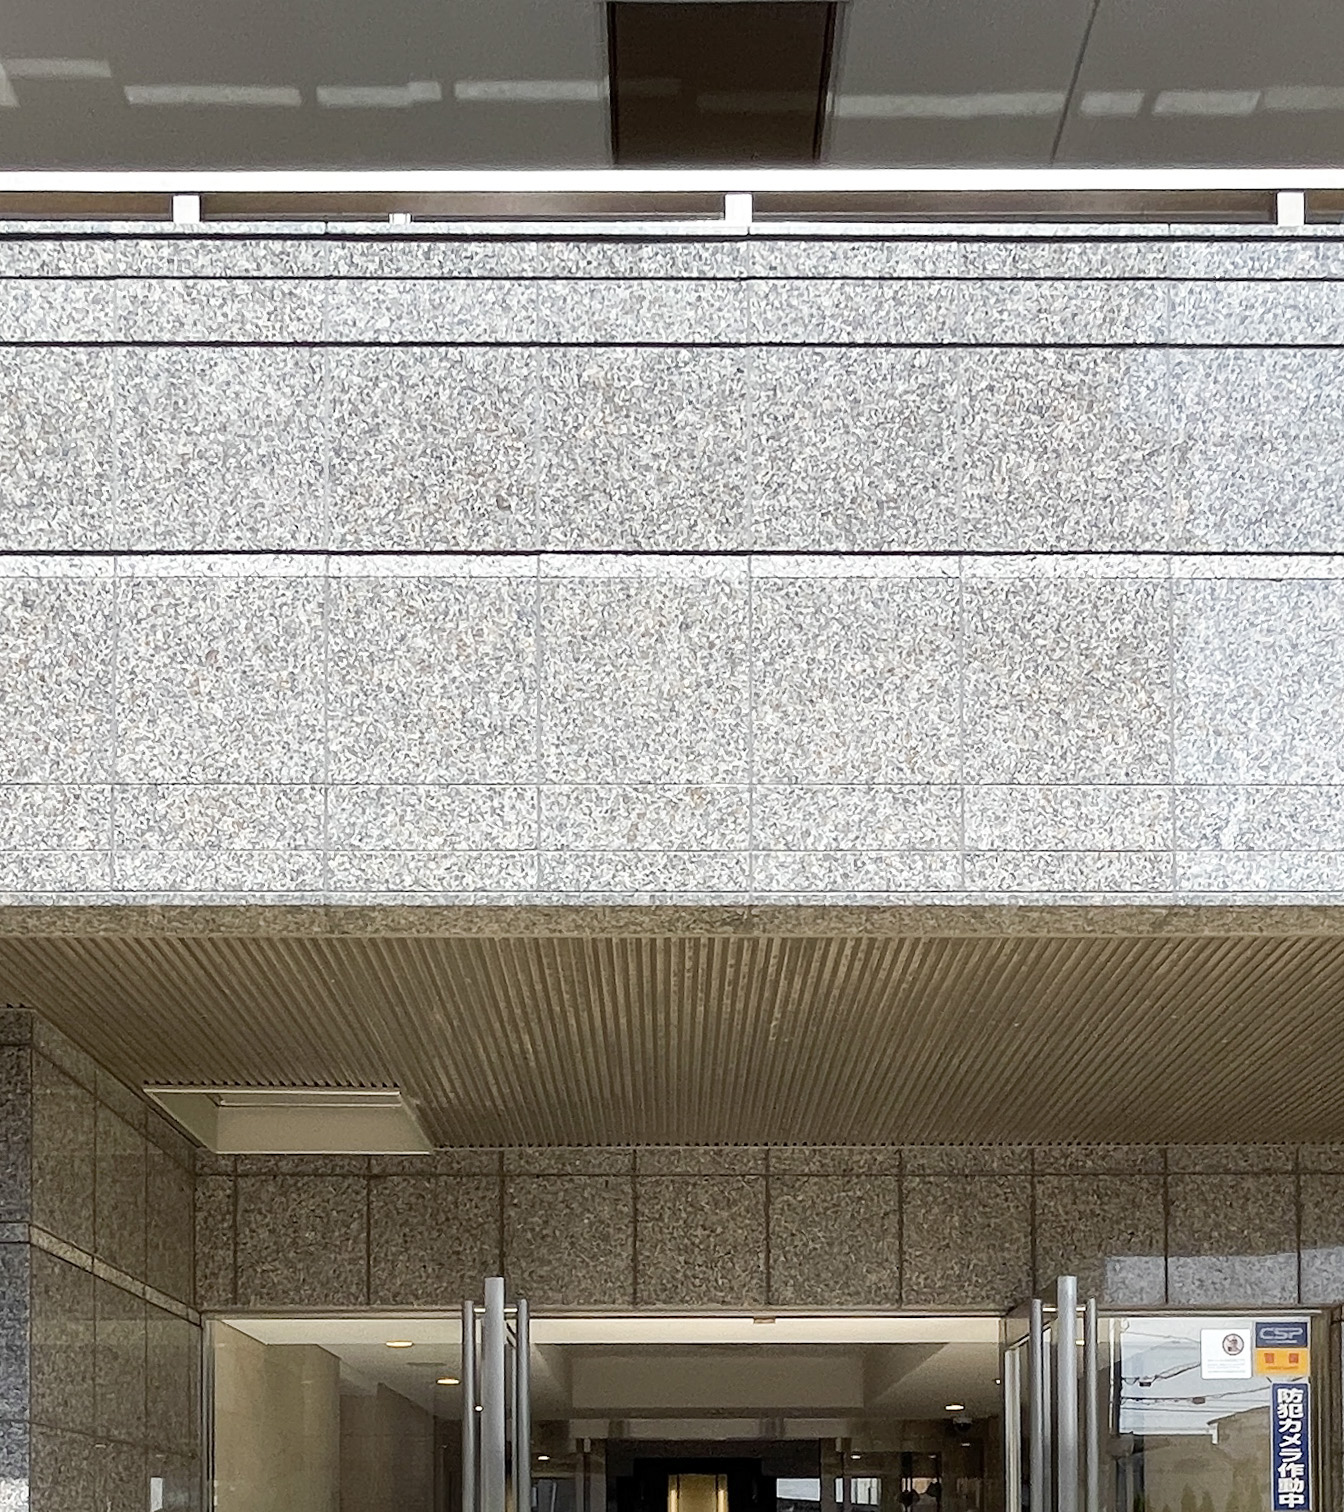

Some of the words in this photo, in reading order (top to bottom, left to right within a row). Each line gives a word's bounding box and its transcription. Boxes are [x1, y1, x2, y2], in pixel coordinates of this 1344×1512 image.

[1259, 1327, 1304, 1340] CSP
[1276, 1387, 1305, 1508] 防犯カメラ作動中
